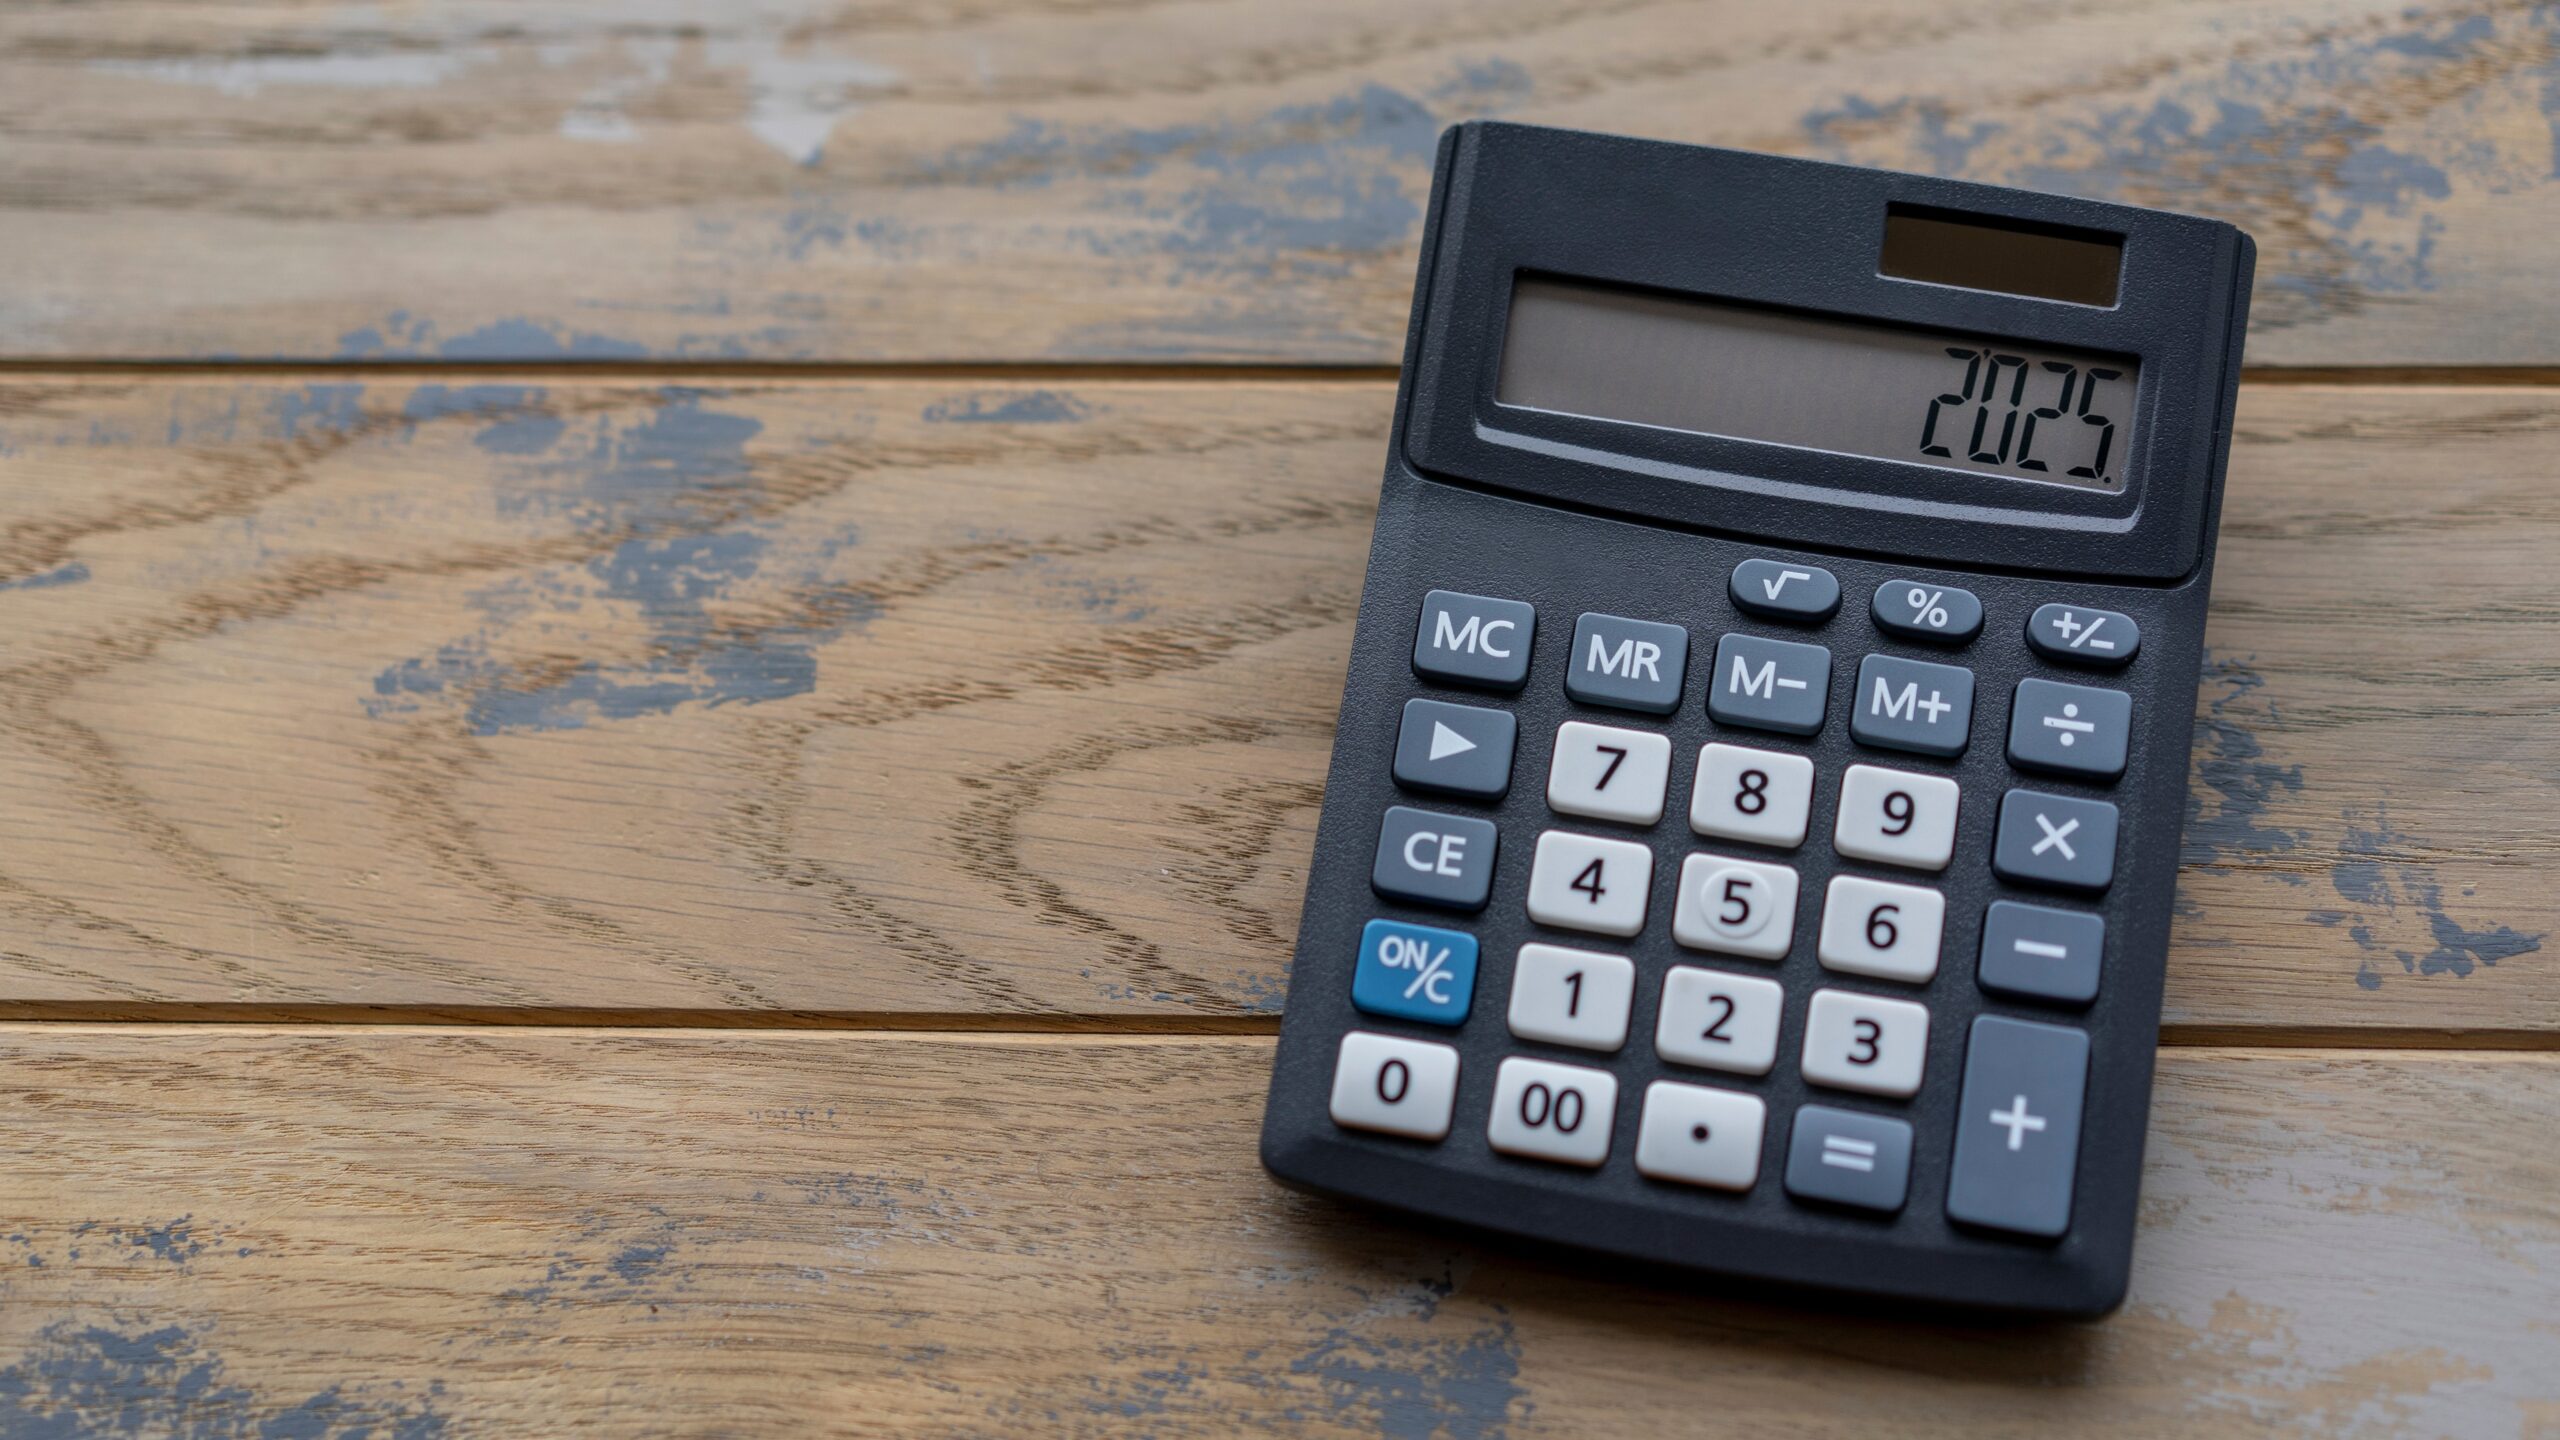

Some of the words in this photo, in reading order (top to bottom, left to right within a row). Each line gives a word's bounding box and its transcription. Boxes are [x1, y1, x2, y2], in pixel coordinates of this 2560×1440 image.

[1907, 588, 1949, 628] %
[1433, 610, 1515, 658] MC
[1586, 633, 1661, 682] MR
[1871, 676, 1952, 724] M+
[1595, 745, 1628, 791] 7
[1734, 769, 1769, 816] 8
[1881, 790, 1915, 837] 9
[1404, 831, 1467, 877] CE
[1570, 858, 1606, 904] 4
[1719, 878, 1753, 926] 5
[1866, 904, 1900, 950] 6
[1378, 935, 1454, 1004] ON/C
[1565, 971, 1583, 1017] 1
[1702, 994, 1735, 1043] 2
[1847, 1018, 1882, 1066] 3
[1376, 1059, 1411, 1106] 0
[1519, 1082, 1585, 1136] 00
